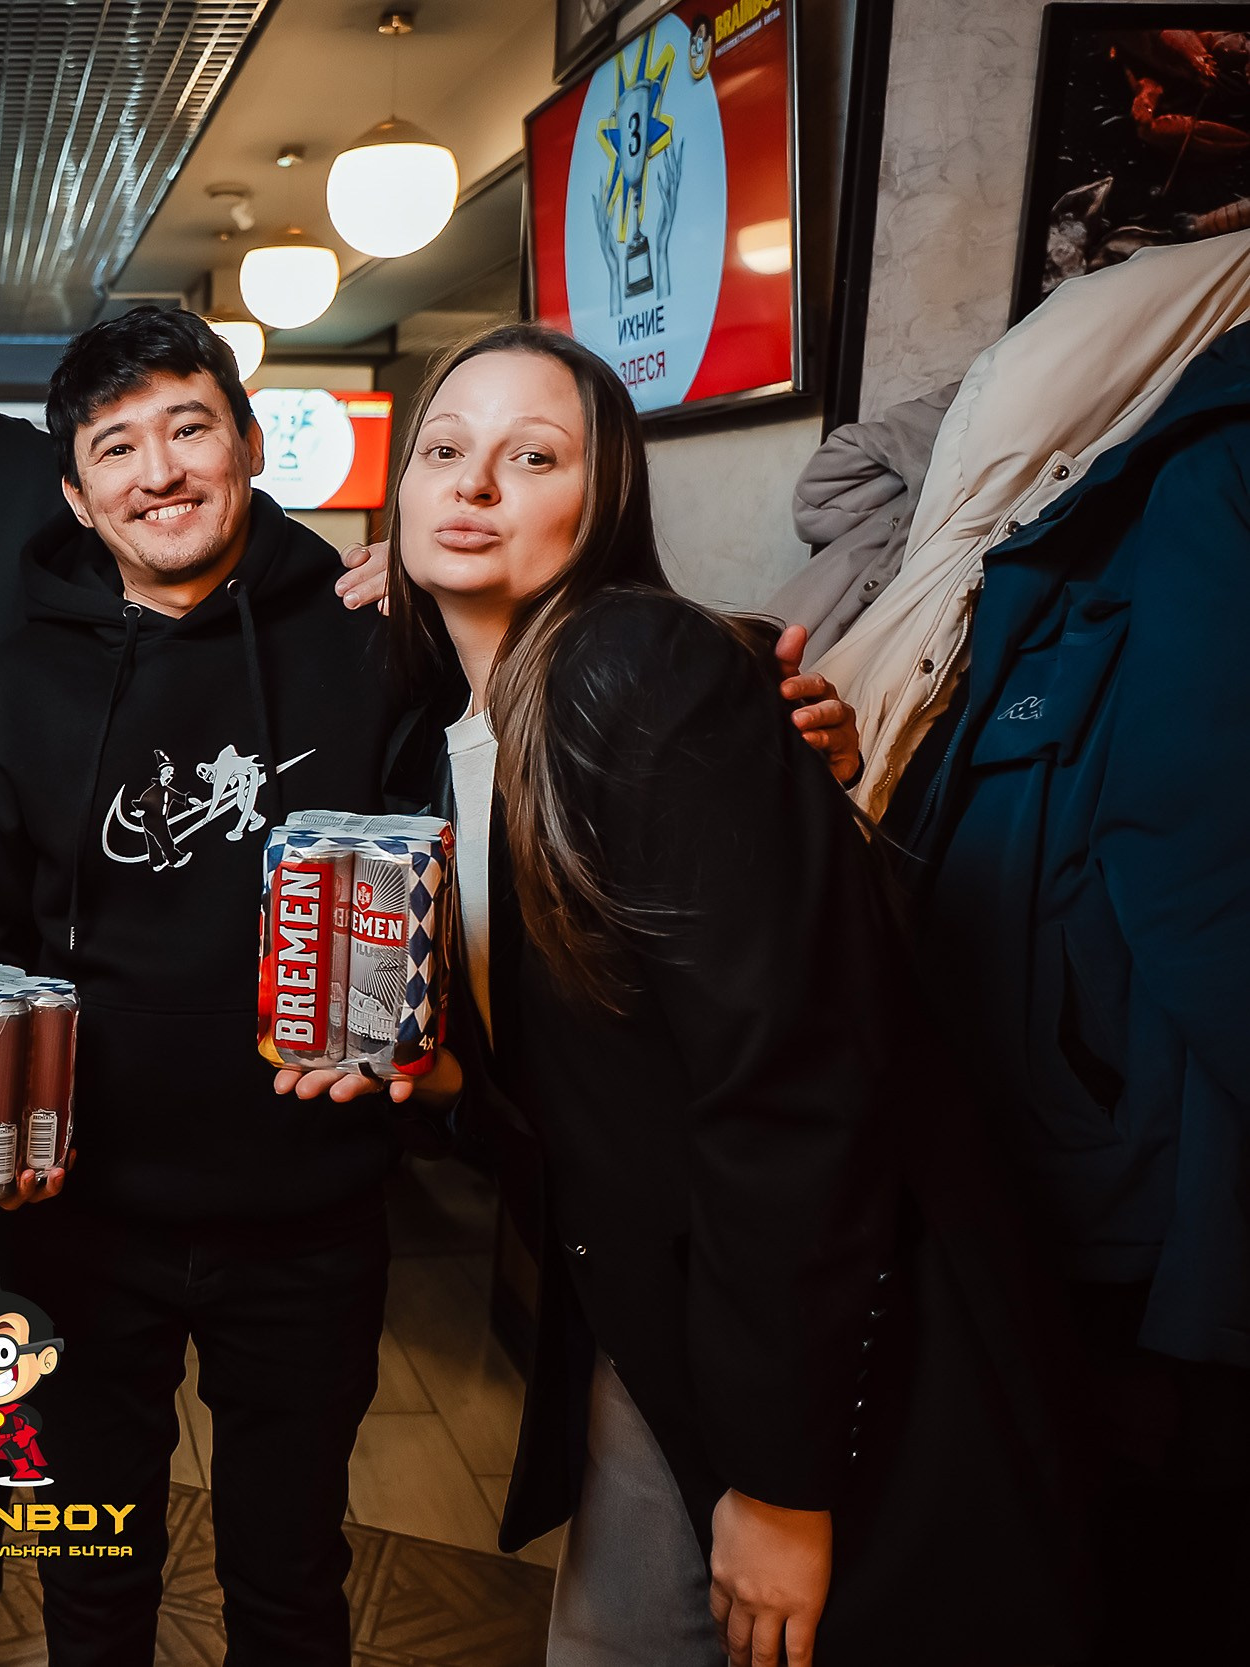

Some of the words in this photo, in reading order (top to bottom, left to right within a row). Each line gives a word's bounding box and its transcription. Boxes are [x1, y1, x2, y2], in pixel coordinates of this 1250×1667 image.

[628, 112, 641, 157] 3
[618, 305, 665, 345] ИХНИЕ
[619, 350, 665, 390] ЗДЕСЯ
[352, 910, 403, 940] EMEN
[275, 868, 321, 1044] BREMEN
